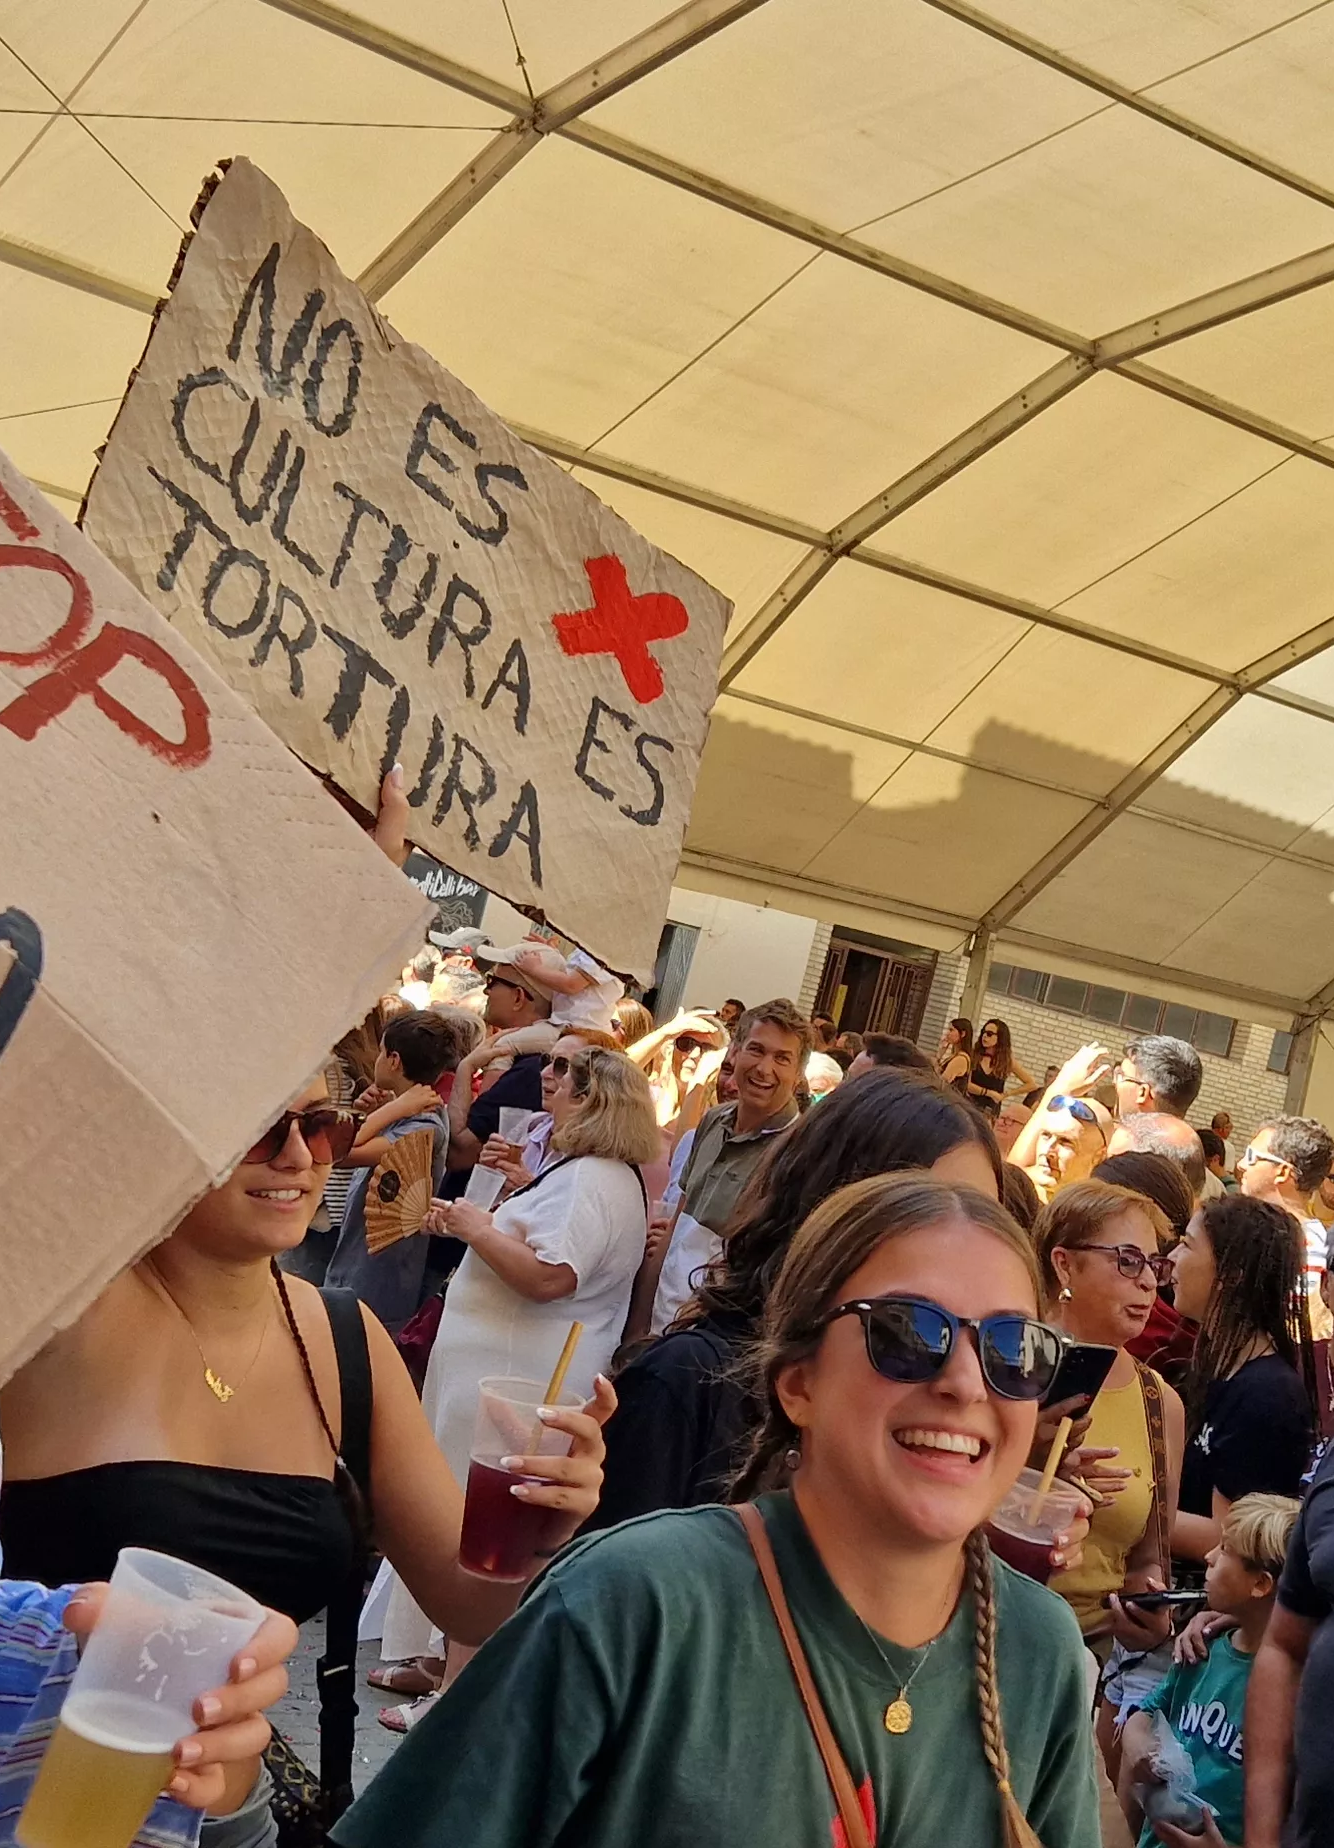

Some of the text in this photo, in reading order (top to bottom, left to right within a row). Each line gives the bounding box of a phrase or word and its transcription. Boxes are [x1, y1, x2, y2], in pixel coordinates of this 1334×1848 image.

[170, 366, 675, 828] CULTURA ES
[226, 242, 529, 548] NO ES
[147, 465, 544, 890] TORTURA
